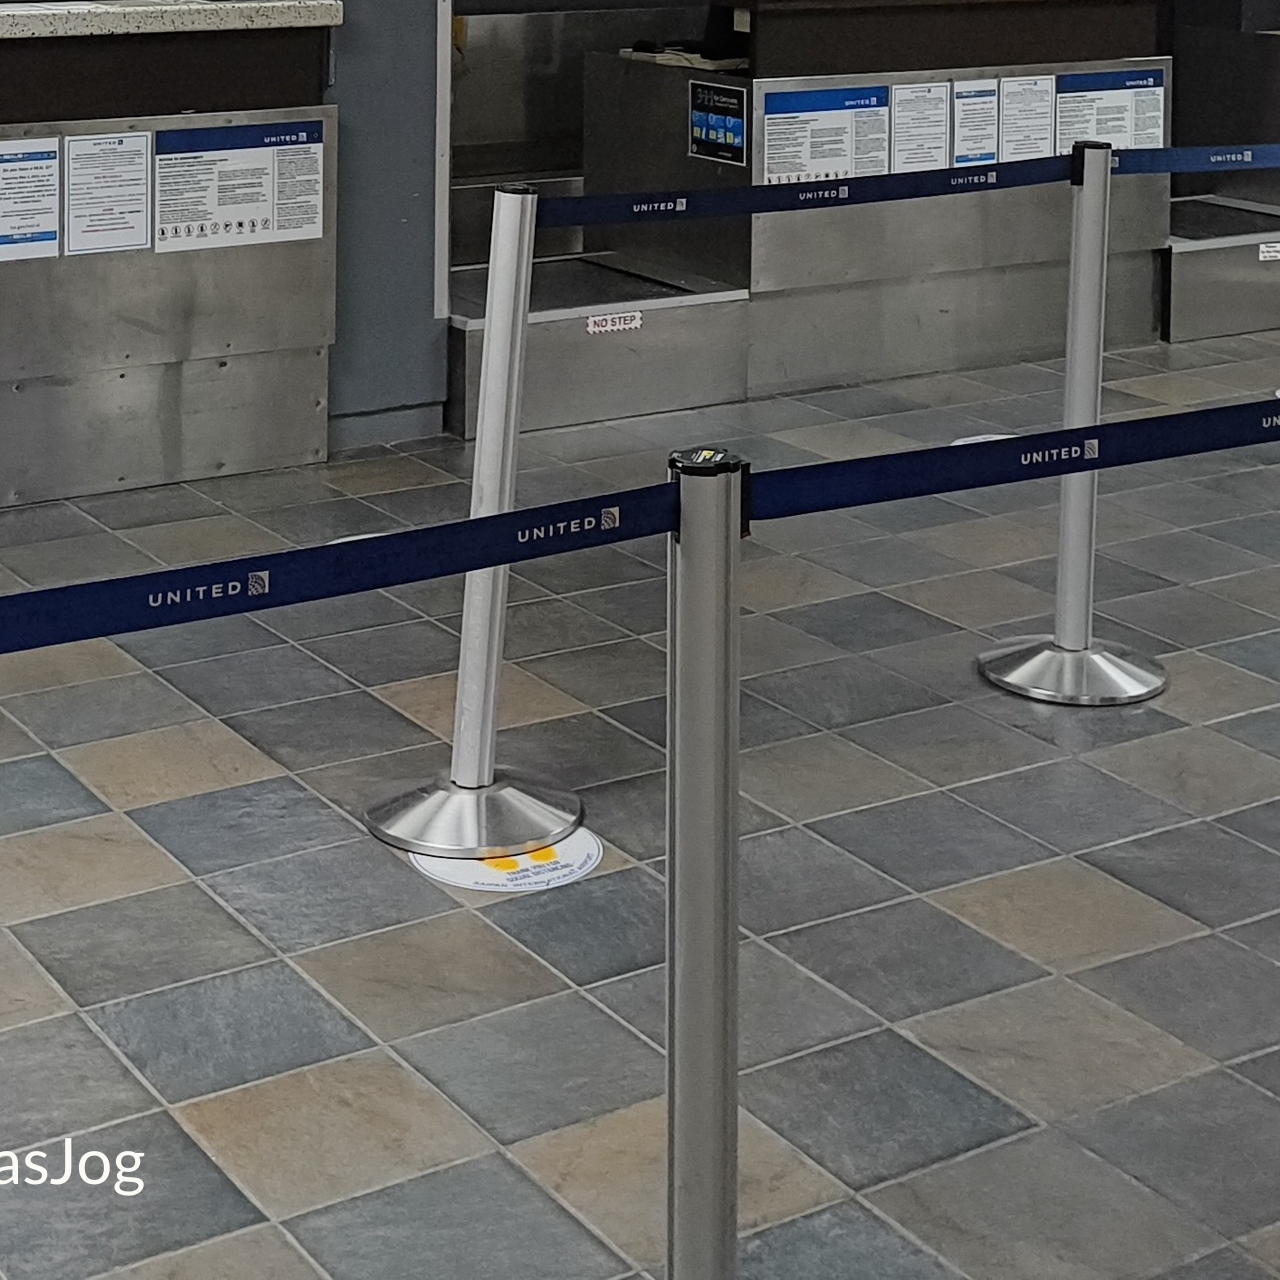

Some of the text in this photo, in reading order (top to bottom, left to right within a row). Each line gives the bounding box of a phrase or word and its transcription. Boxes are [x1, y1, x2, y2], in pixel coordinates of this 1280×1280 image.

[264, 135, 297, 144] UNITED
[1210, 153, 1243, 162] UNITED
[951, 175, 986, 185] UNITED
[799, 190, 837, 200] UNITED
[633, 202, 674, 212] UNITED
[593, 315, 636, 328] NO STEP
[1021, 446, 1081, 465] UNITED
[517, 517, 596, 542] UNITED
[148, 581, 241, 607] UNITED
